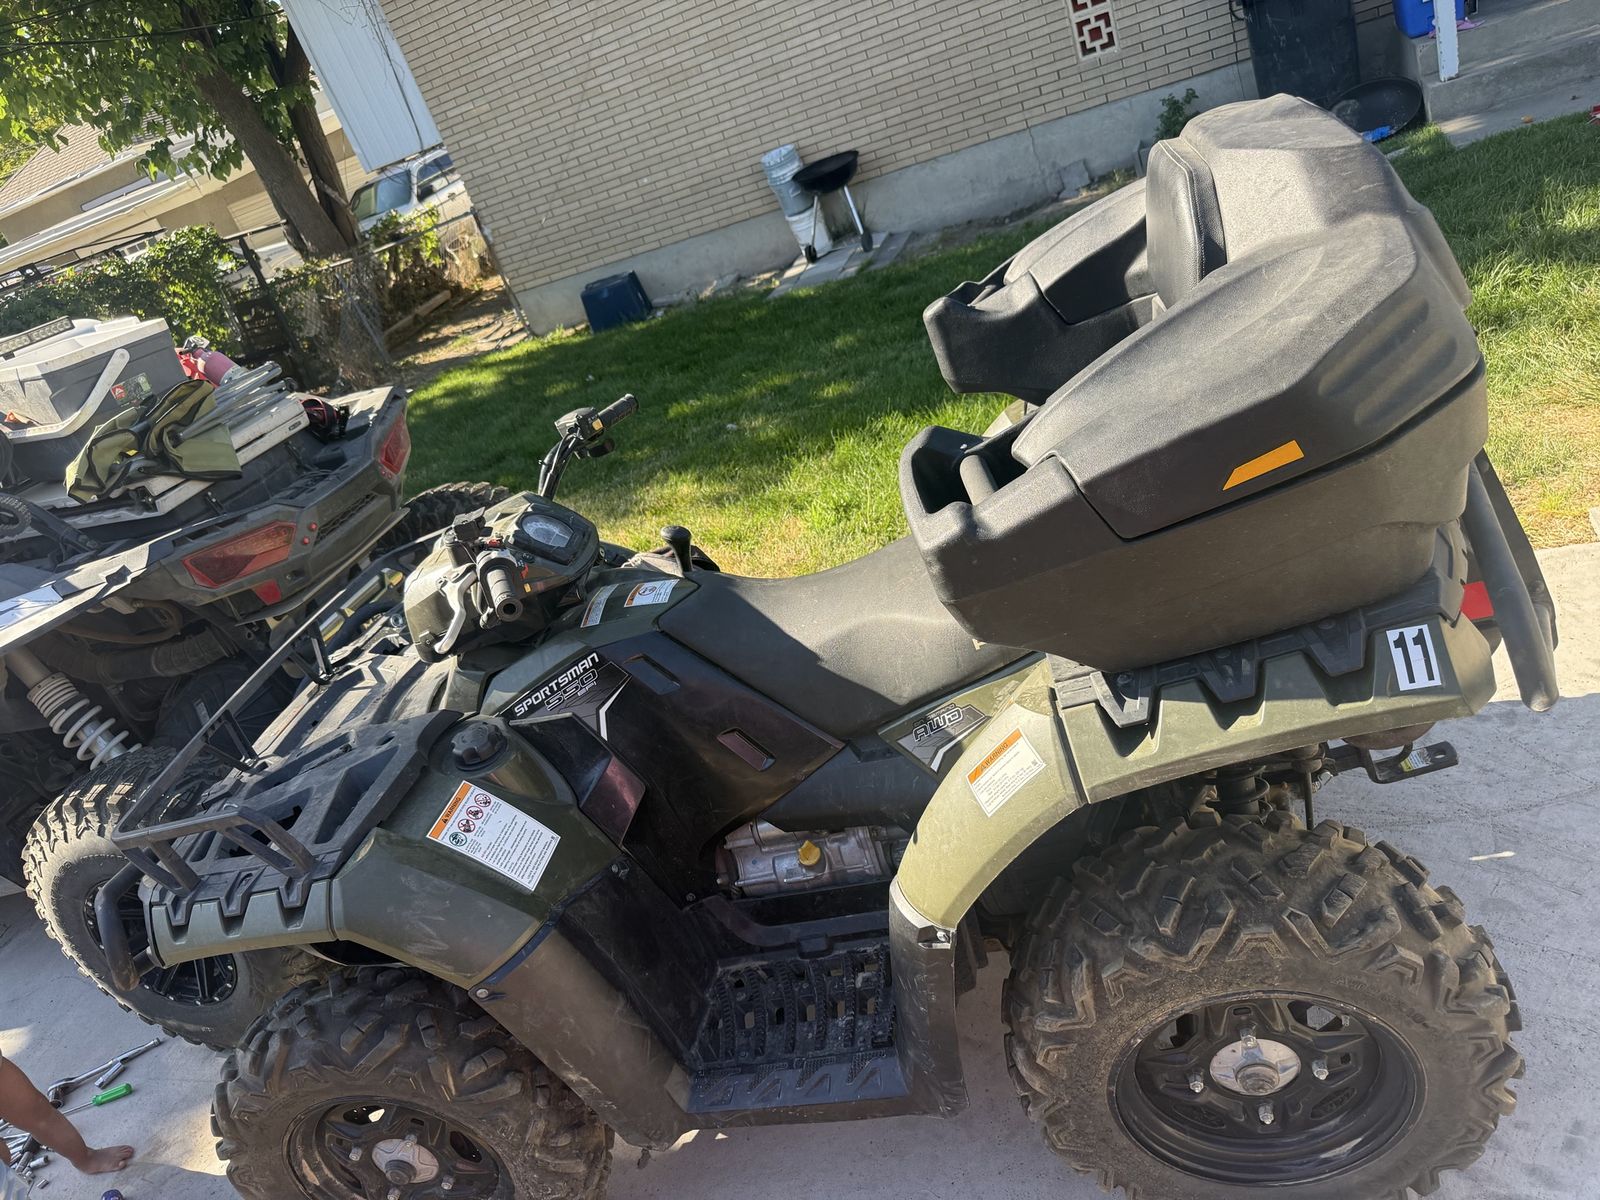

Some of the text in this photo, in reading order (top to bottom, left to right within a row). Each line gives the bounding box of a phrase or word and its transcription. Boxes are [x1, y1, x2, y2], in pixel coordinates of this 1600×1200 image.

[1393, 628, 1435, 684] 11
[514, 652, 599, 717] SPORTSMAN
[544, 668, 598, 711] 550
[912, 707, 963, 742] AWD
[985, 742, 1009, 770] WARNING
[446, 797, 461, 818] WARNING
